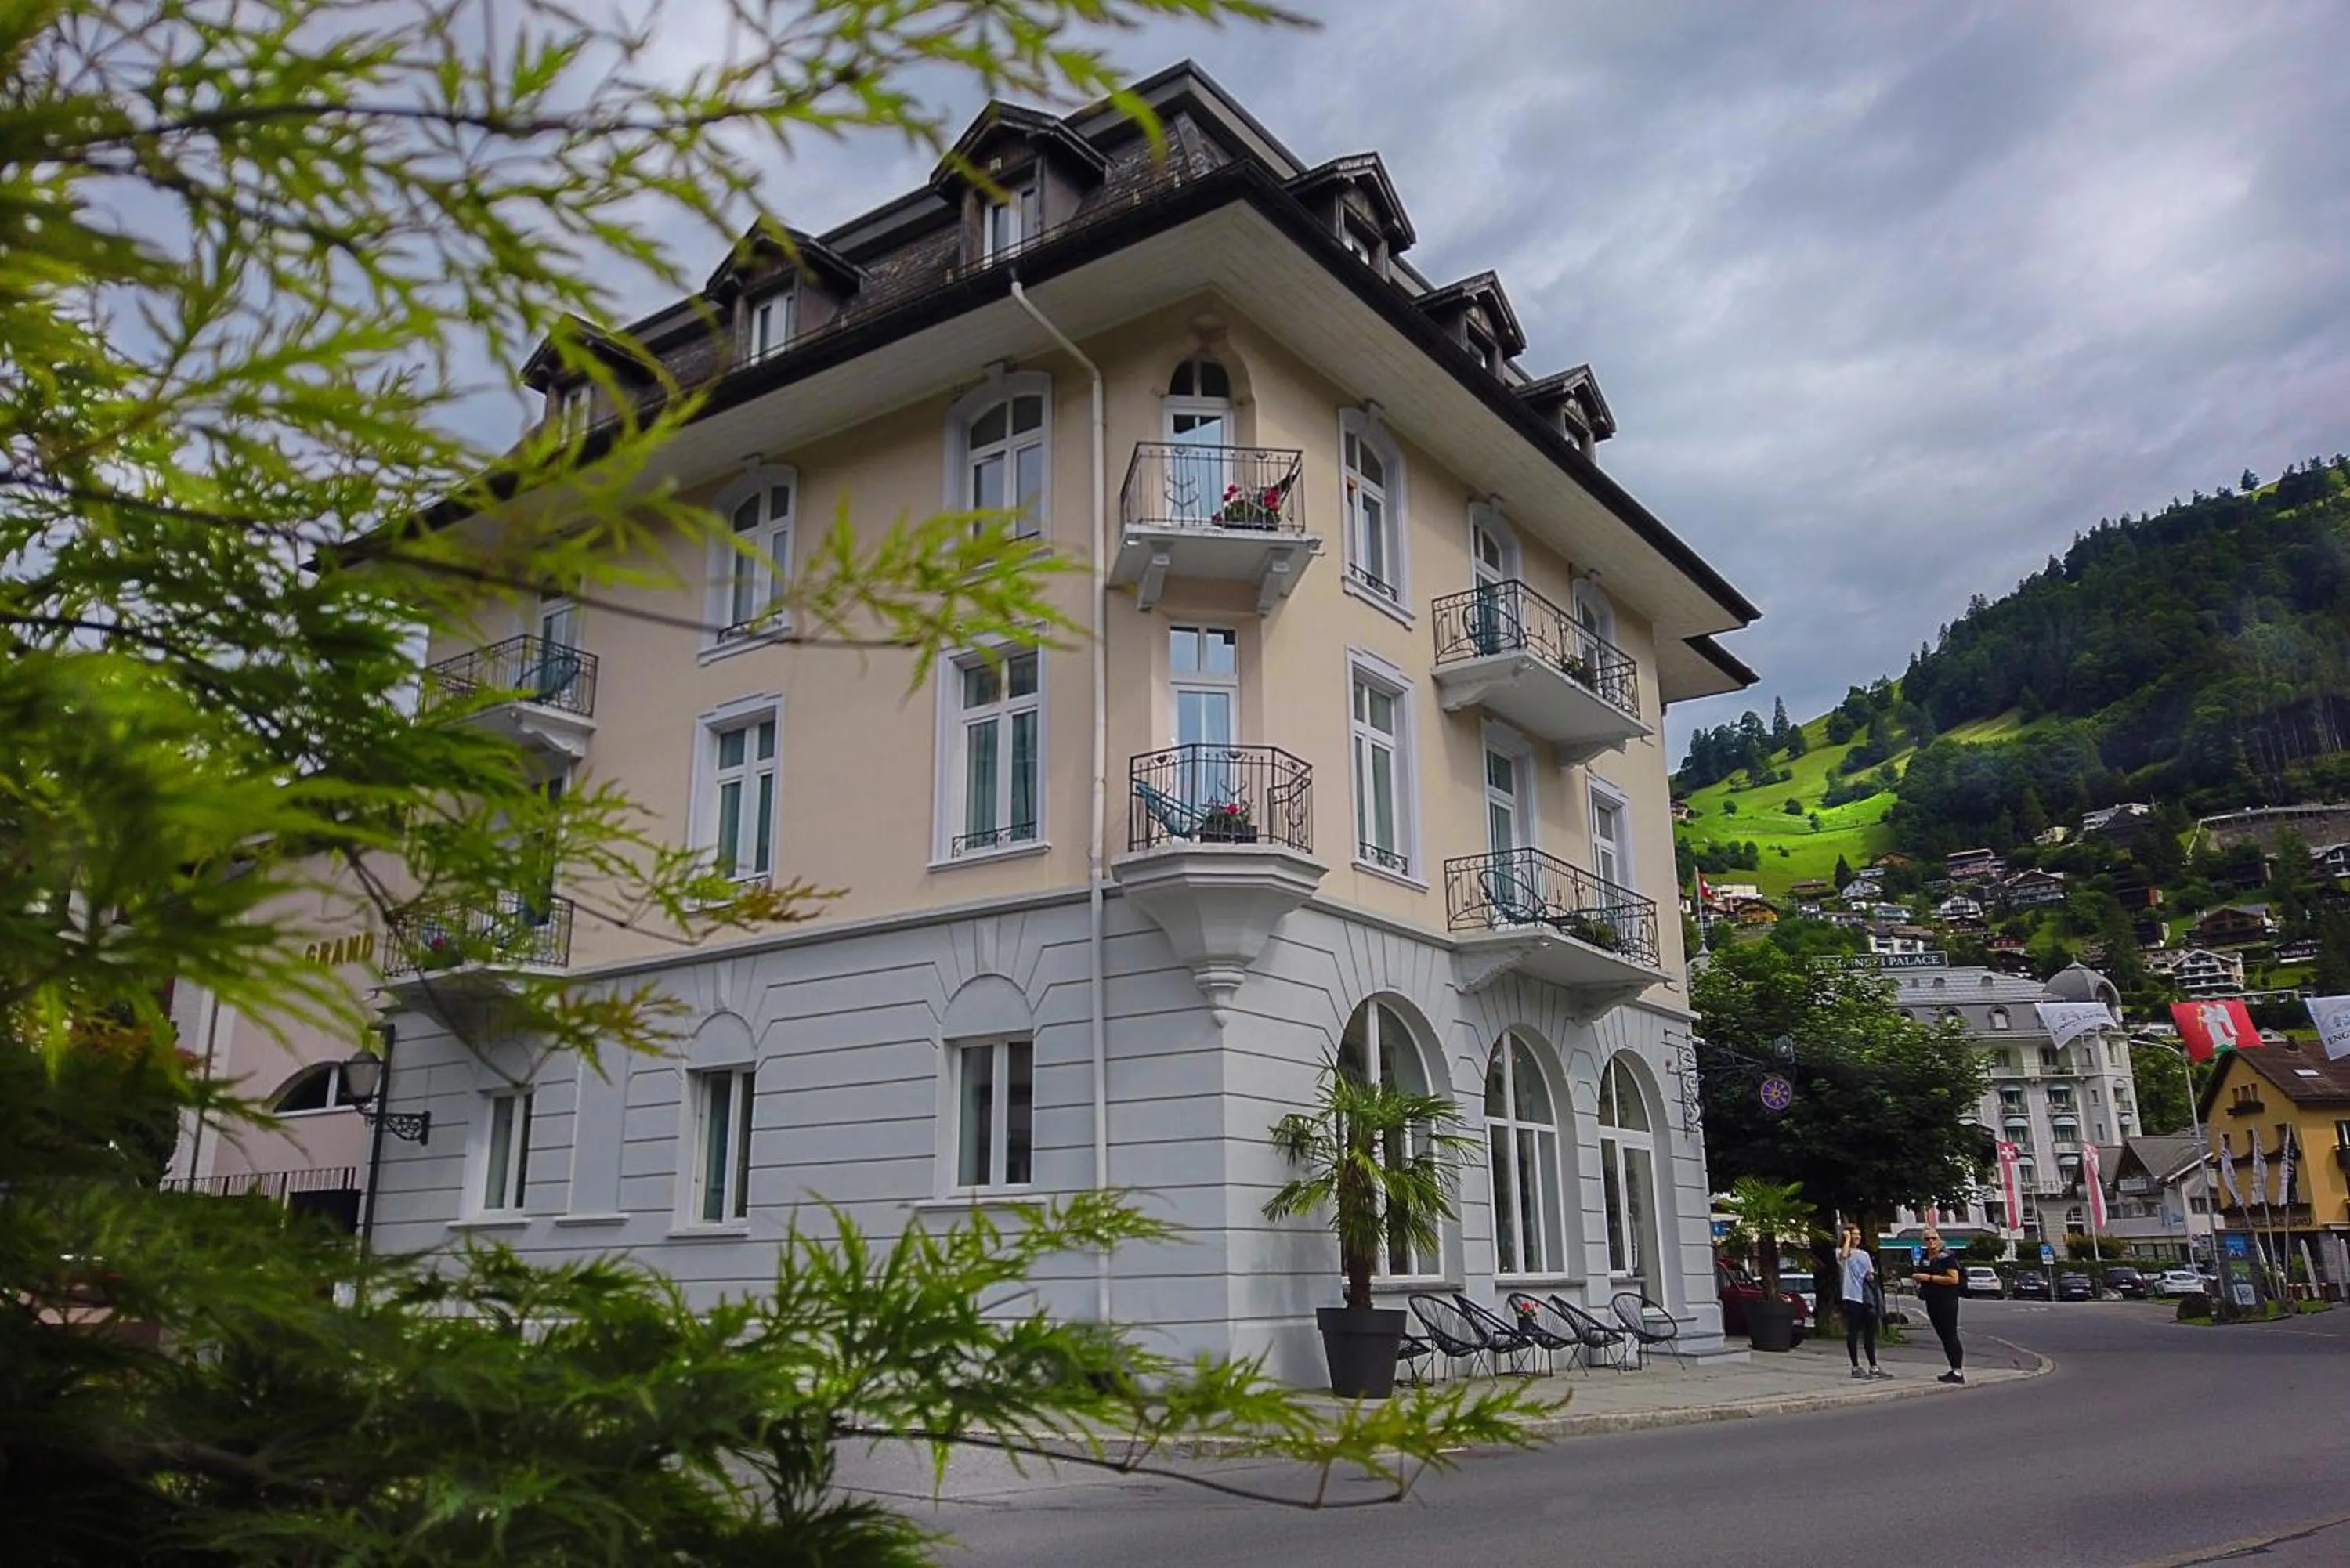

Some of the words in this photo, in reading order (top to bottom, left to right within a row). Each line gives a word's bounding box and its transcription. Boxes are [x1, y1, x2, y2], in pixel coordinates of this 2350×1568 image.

[305, 931, 374, 966] GRAND
[1888, 955, 1940, 966] PALACE
[2327, 1031, 2350, 1045] ENG
